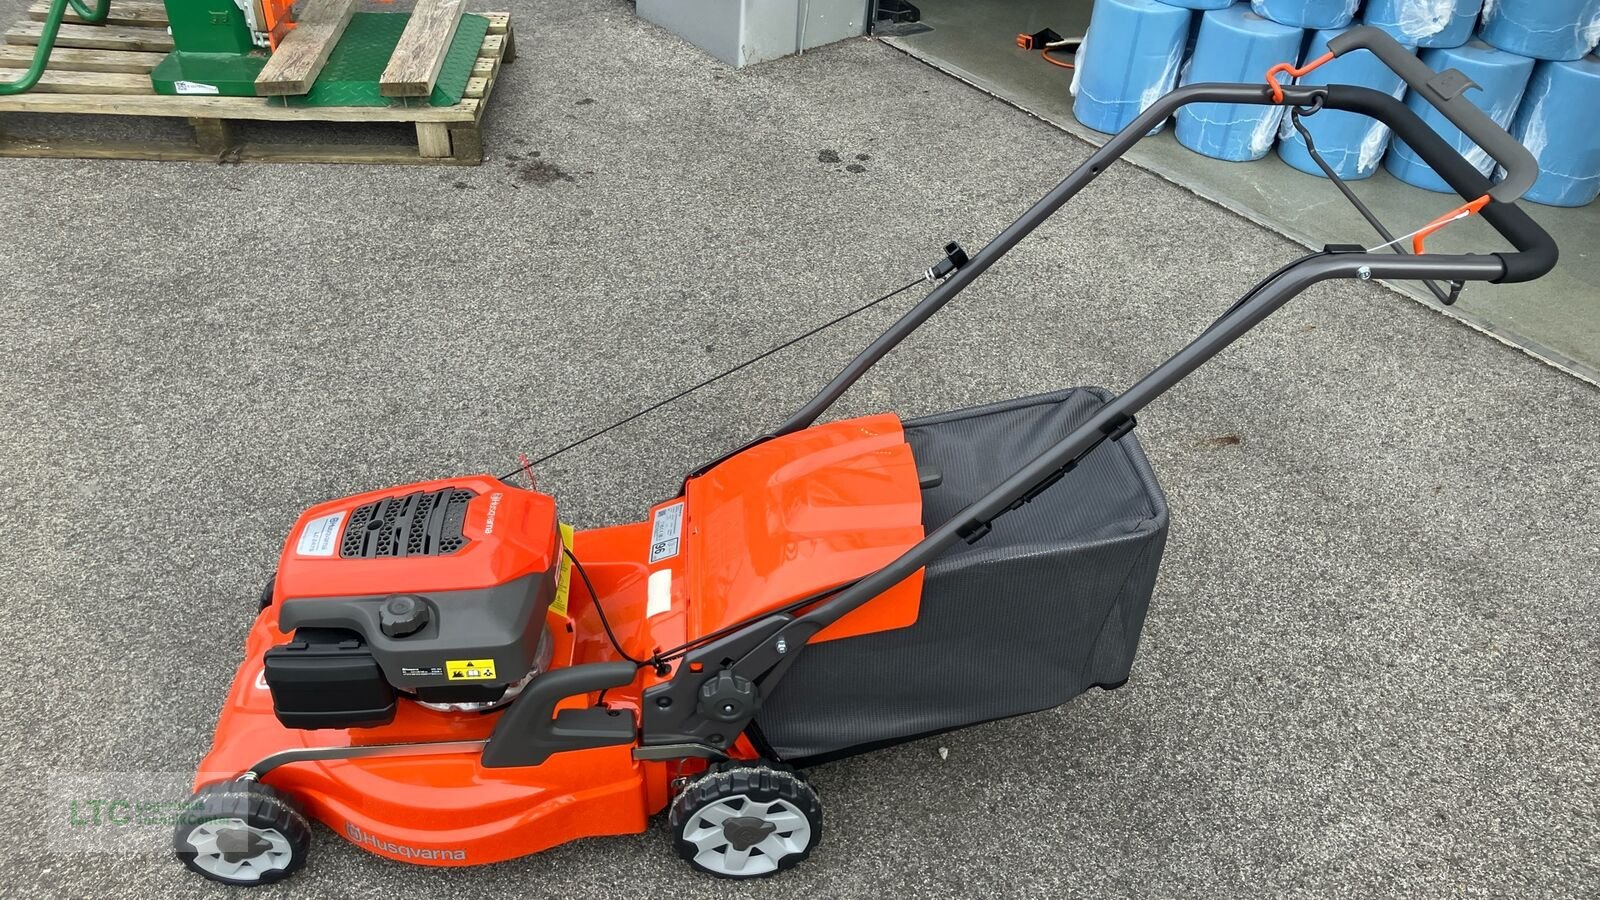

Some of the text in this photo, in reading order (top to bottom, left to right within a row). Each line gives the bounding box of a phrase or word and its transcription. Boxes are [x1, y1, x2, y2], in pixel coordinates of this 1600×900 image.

[485, 498, 501, 534] Husqvarna
[654, 542, 666, 555] 96
[363, 832, 466, 860] Husqvarna
